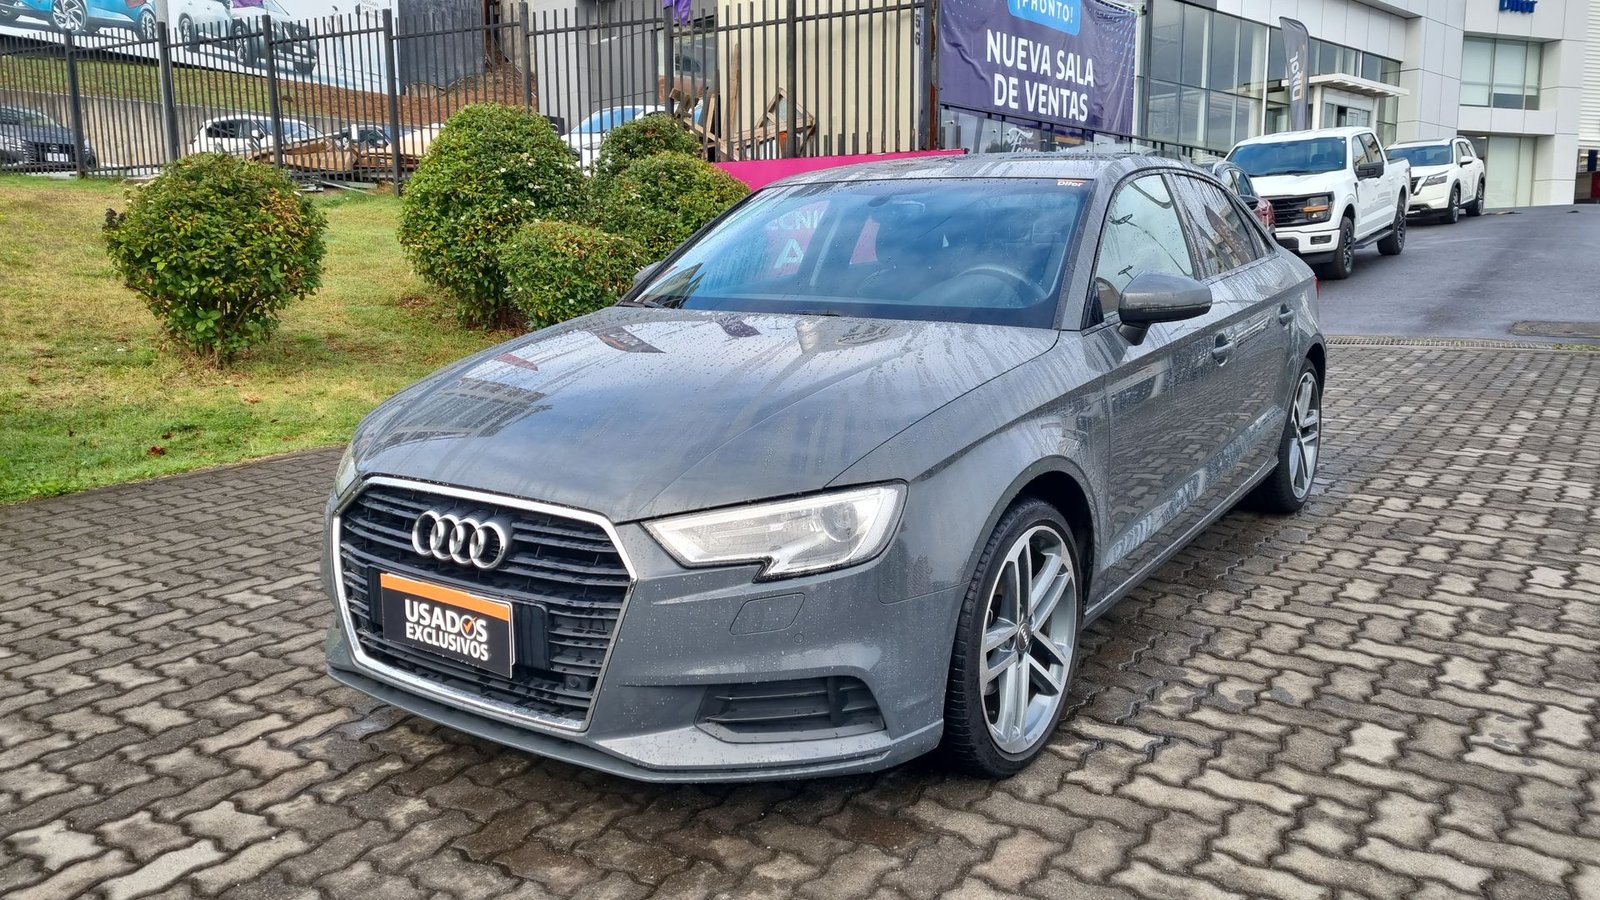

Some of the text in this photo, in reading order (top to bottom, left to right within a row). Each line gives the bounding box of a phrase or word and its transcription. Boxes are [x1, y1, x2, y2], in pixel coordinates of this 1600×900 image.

[986, 29, 1094, 87] NUEVA SALA
[994, 73, 1089, 122] DE VENTAS
[404, 599, 487, 643] USADOS
[405, 622, 489, 661] EXCLUSIVOS
